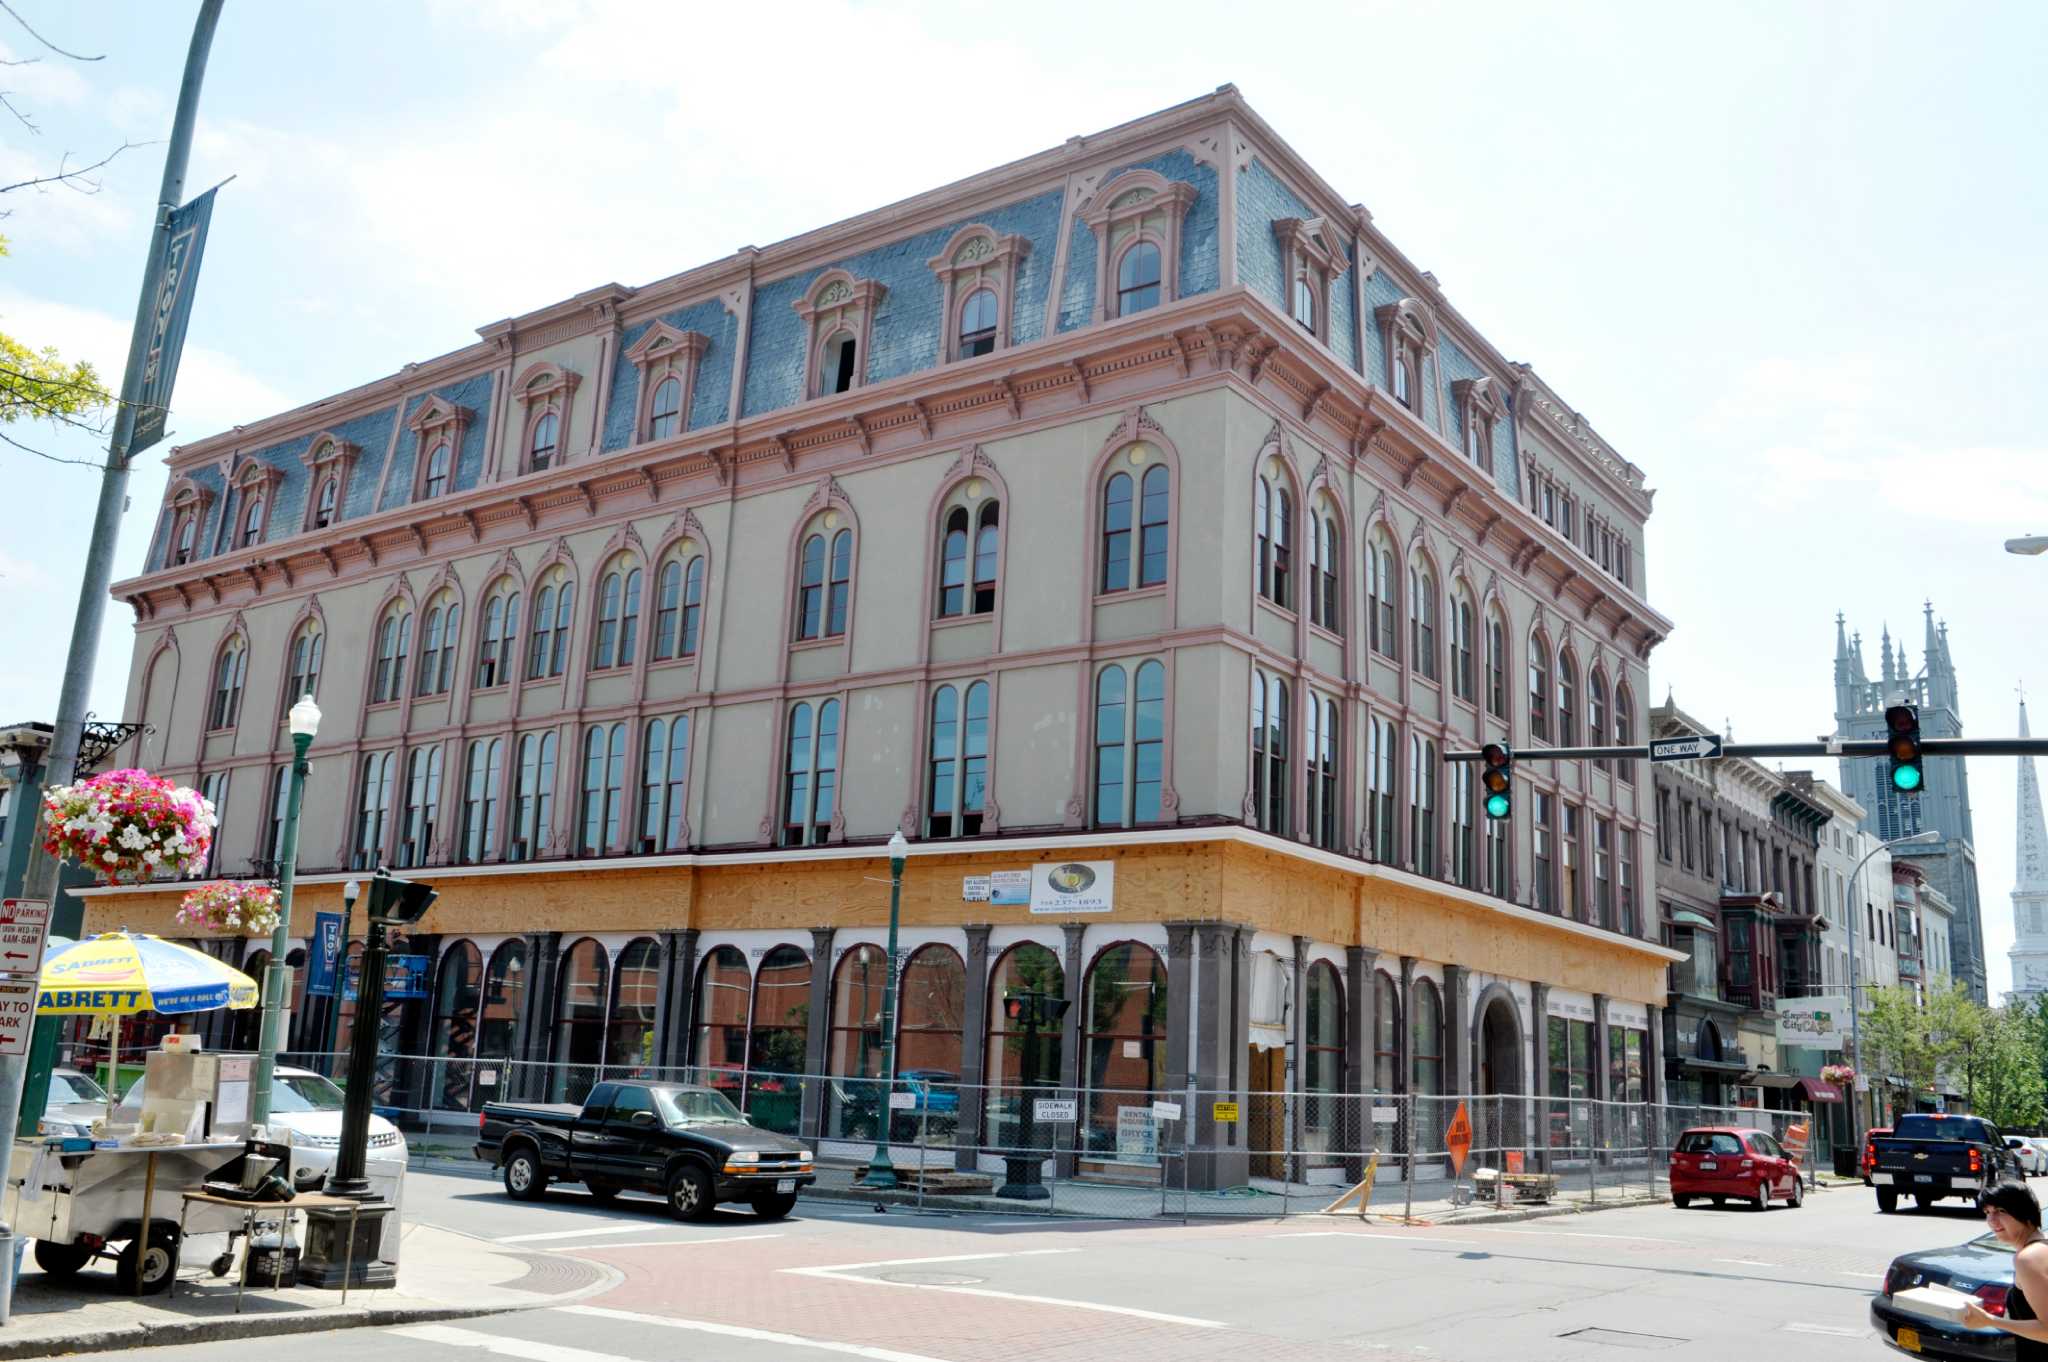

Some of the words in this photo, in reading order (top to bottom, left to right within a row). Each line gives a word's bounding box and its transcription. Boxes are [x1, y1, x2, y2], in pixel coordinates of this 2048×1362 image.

[157, 245, 183, 334] TROY
[1657, 745, 1676, 755] ONE
[1680, 743, 1698, 753] WAY
[2, 904, 16, 919] NO
[16, 908, 47, 918] PARKING
[327, 925, 337, 957] TROY
[37, 990, 142, 1008] ABRETT
[13, 1001, 29, 1013] TO
[0, 1016, 21, 1028] ARK
[1782, 1019, 1802, 1032] City
[1038, 1102, 1072, 1110] SIDEWALK
[1041, 1111, 1069, 1119] CLOSED
[1124, 1111, 1151, 1119] RENTAL
